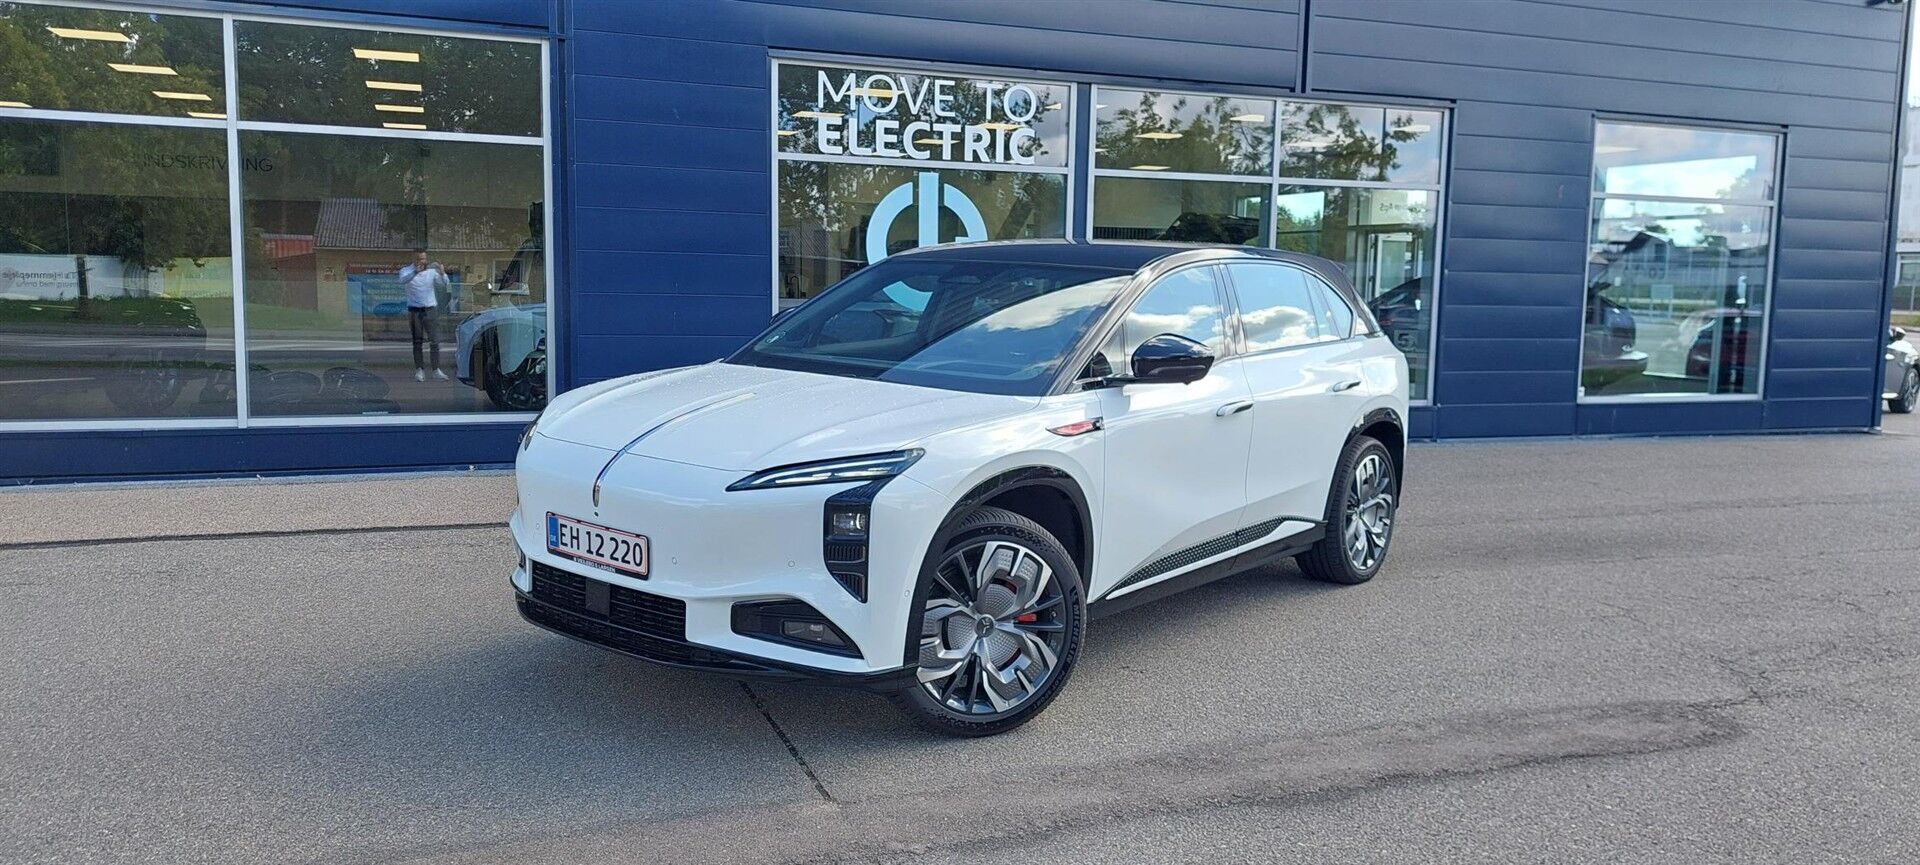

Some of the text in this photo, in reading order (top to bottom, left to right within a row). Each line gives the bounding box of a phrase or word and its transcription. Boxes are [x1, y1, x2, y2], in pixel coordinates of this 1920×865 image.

[818, 70, 1037, 122] MOVE TO
[143, 153, 273, 172] INDSKRIVING
[817, 116, 1036, 164] ELECTRIC
[560, 523, 643, 567] EH 12 220
[1065, 604, 1080, 665] MICHELIN
